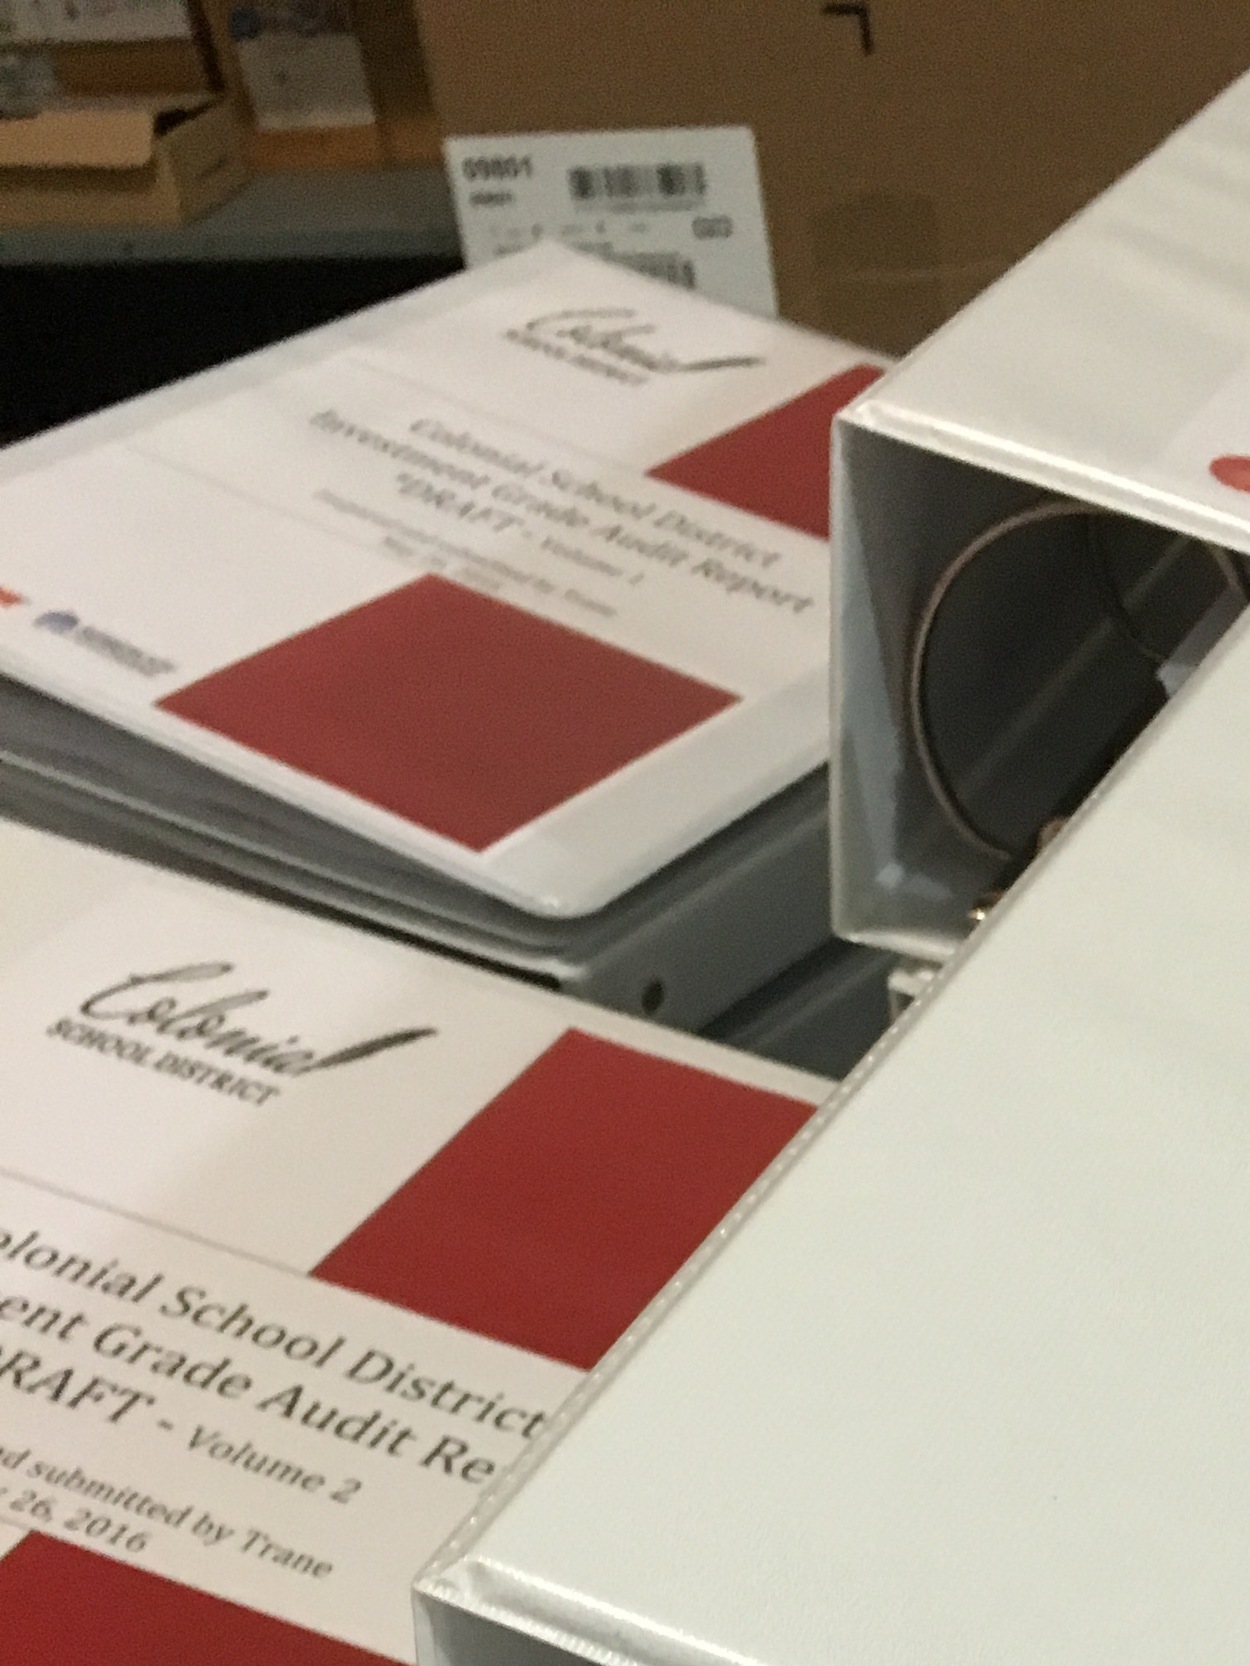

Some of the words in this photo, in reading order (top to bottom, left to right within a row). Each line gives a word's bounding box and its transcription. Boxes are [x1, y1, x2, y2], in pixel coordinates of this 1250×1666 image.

[46, 1016, 154, 1070] SCHOOL
[154, 1048, 283, 1107] DISTRICT
[79, 960, 440, 1078] Colonial
[0, 1340, 157, 1427] RAFT
[184, 1423, 328, 1495] Volume
[328, 1475, 364, 1505] 2
[92, 1320, 256, 1402] Grade
[252, 1382, 418, 1457] Audit
[159, 1284, 347, 1370] School
[344, 1346, 548, 1440] District
[26, 1460, 203, 1530] submitted
[195, 1502, 236, 1550] by
[239, 1527, 334, 1581] Trane
[63, 1506, 153, 1554] 2016
